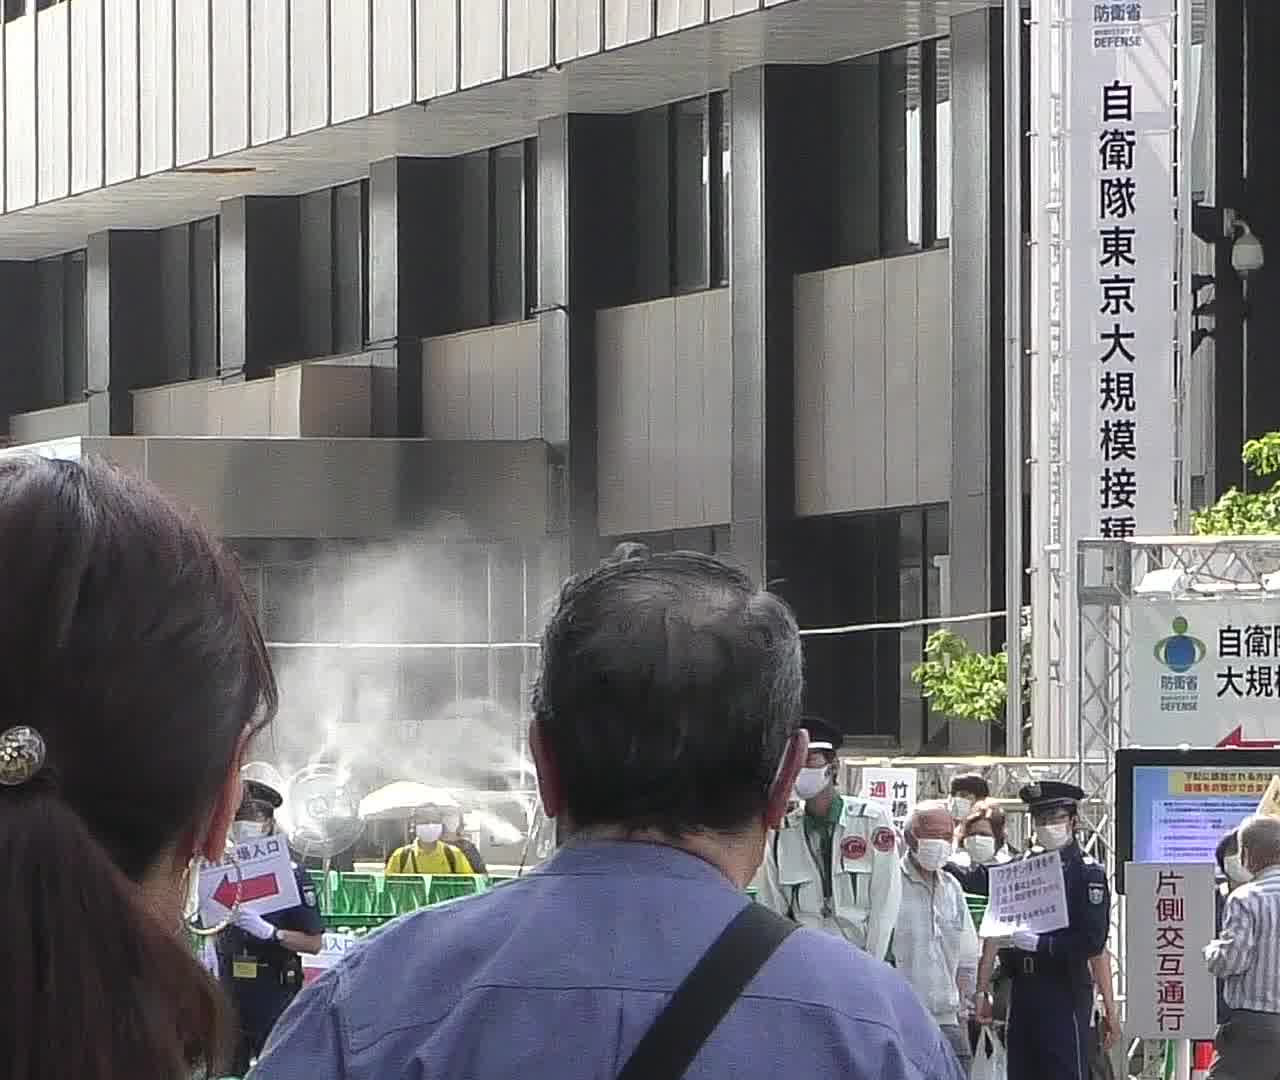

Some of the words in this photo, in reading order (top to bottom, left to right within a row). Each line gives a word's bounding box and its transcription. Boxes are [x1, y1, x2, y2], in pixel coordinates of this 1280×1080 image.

[1094, 36, 1142, 48] DEFENSE
[1156, 871, 1185, 1032] 片側交互通行
